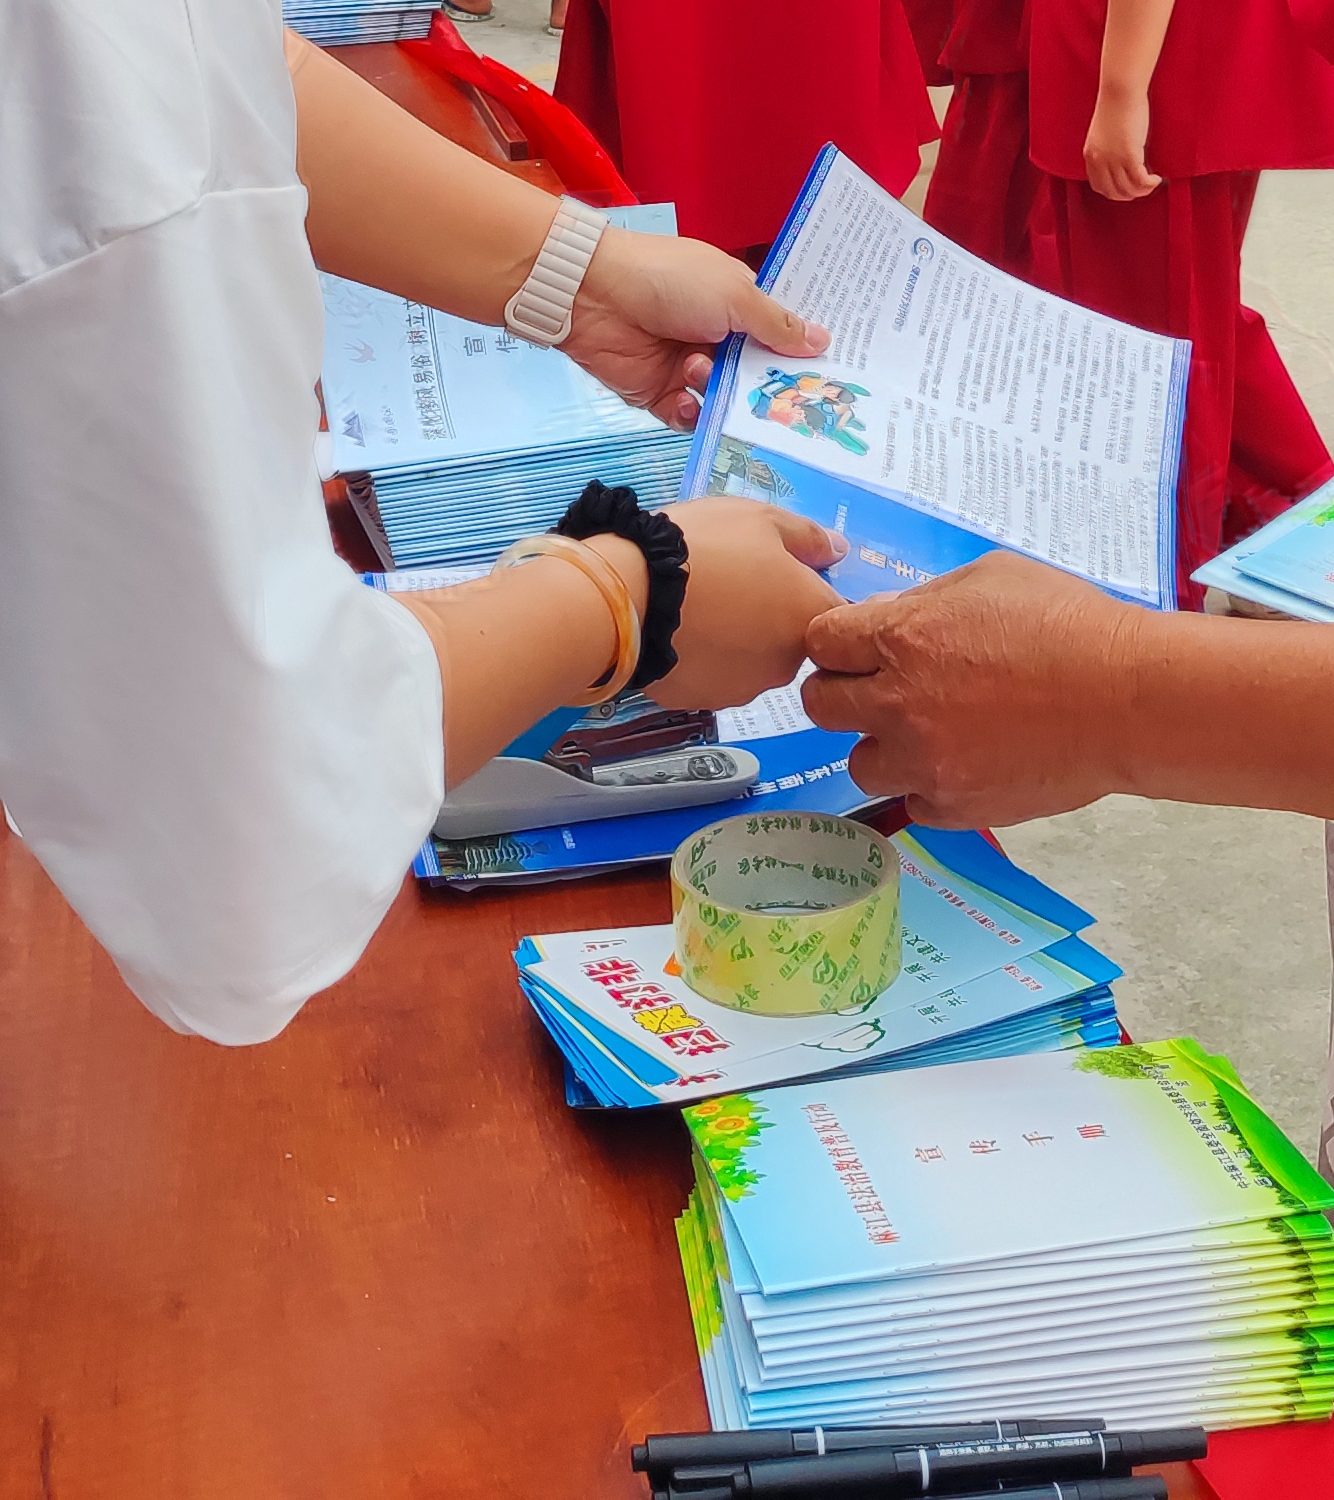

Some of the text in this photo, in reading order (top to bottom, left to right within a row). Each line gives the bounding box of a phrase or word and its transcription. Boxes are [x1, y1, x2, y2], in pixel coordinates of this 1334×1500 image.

[800, 1102, 902, 1245] 麻江县法治教育普及行动
